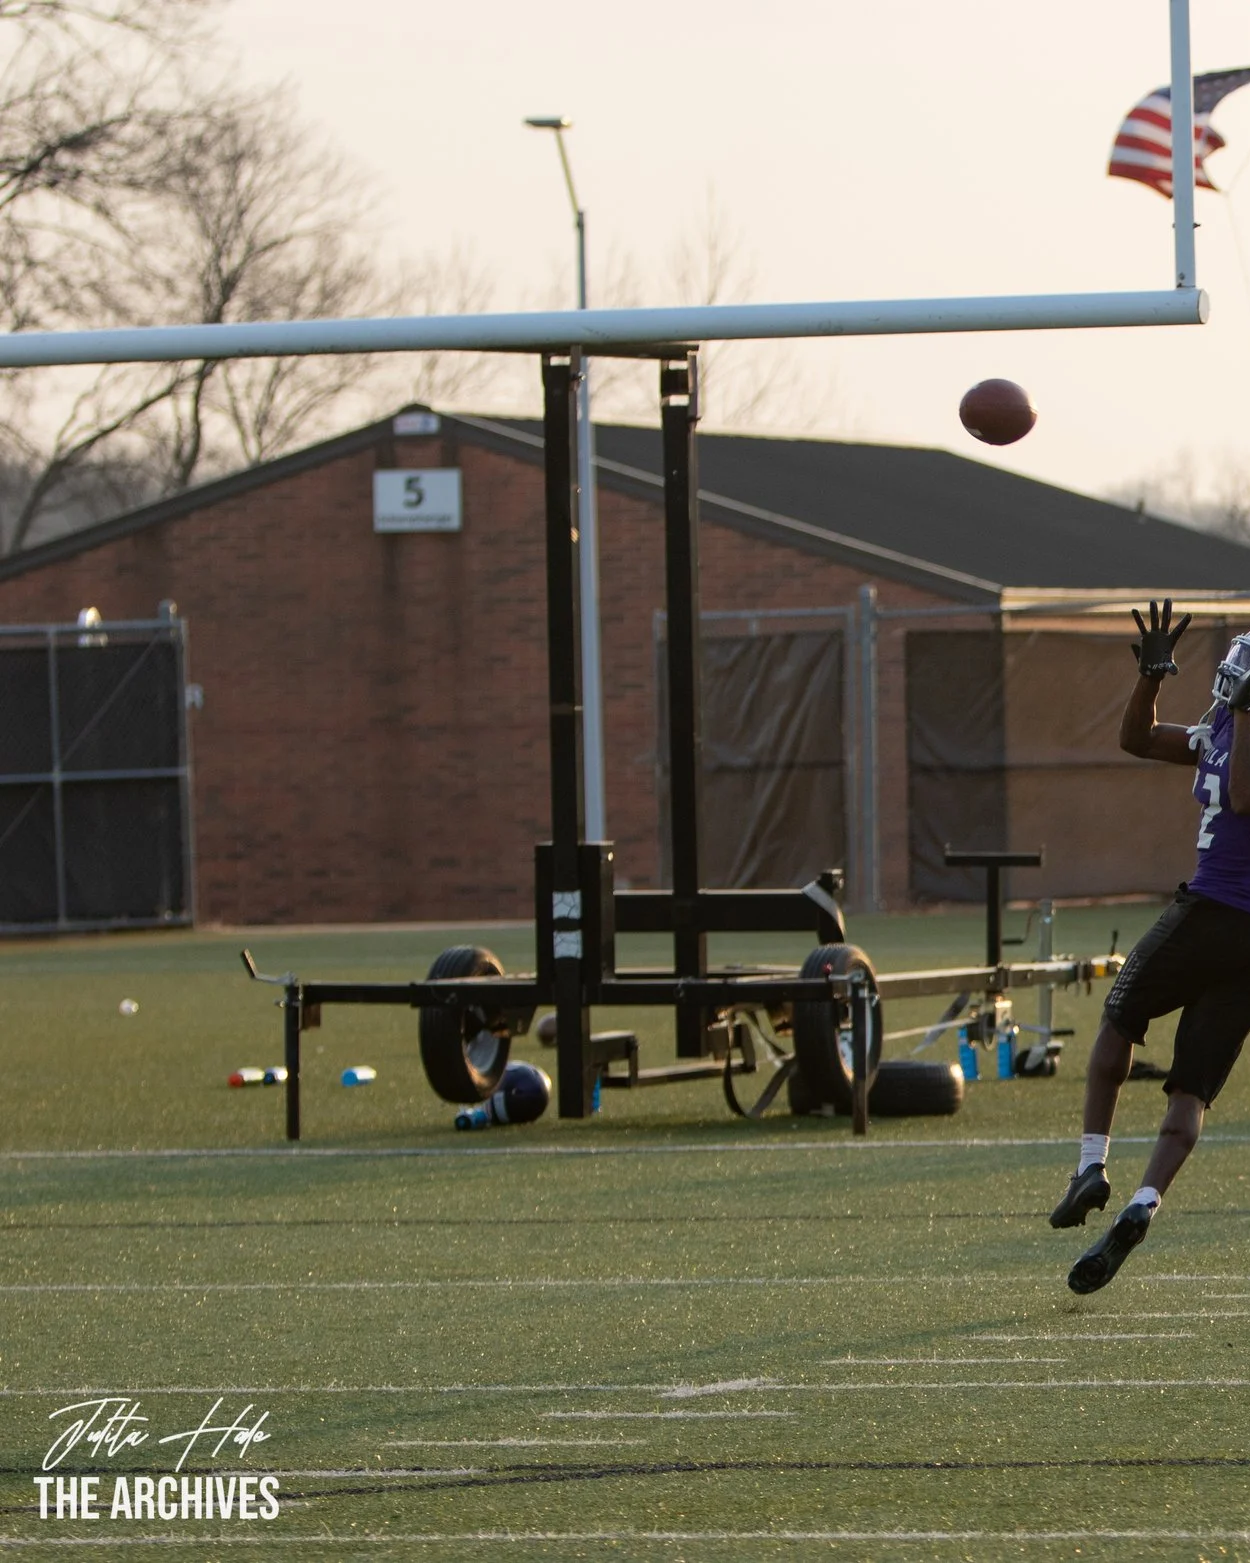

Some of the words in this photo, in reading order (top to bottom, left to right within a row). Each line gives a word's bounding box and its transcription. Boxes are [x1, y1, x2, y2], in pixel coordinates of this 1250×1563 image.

[403, 475, 425, 509] 5
[1203, 747, 1229, 767] ILA
[1192, 767, 1222, 849] 2
